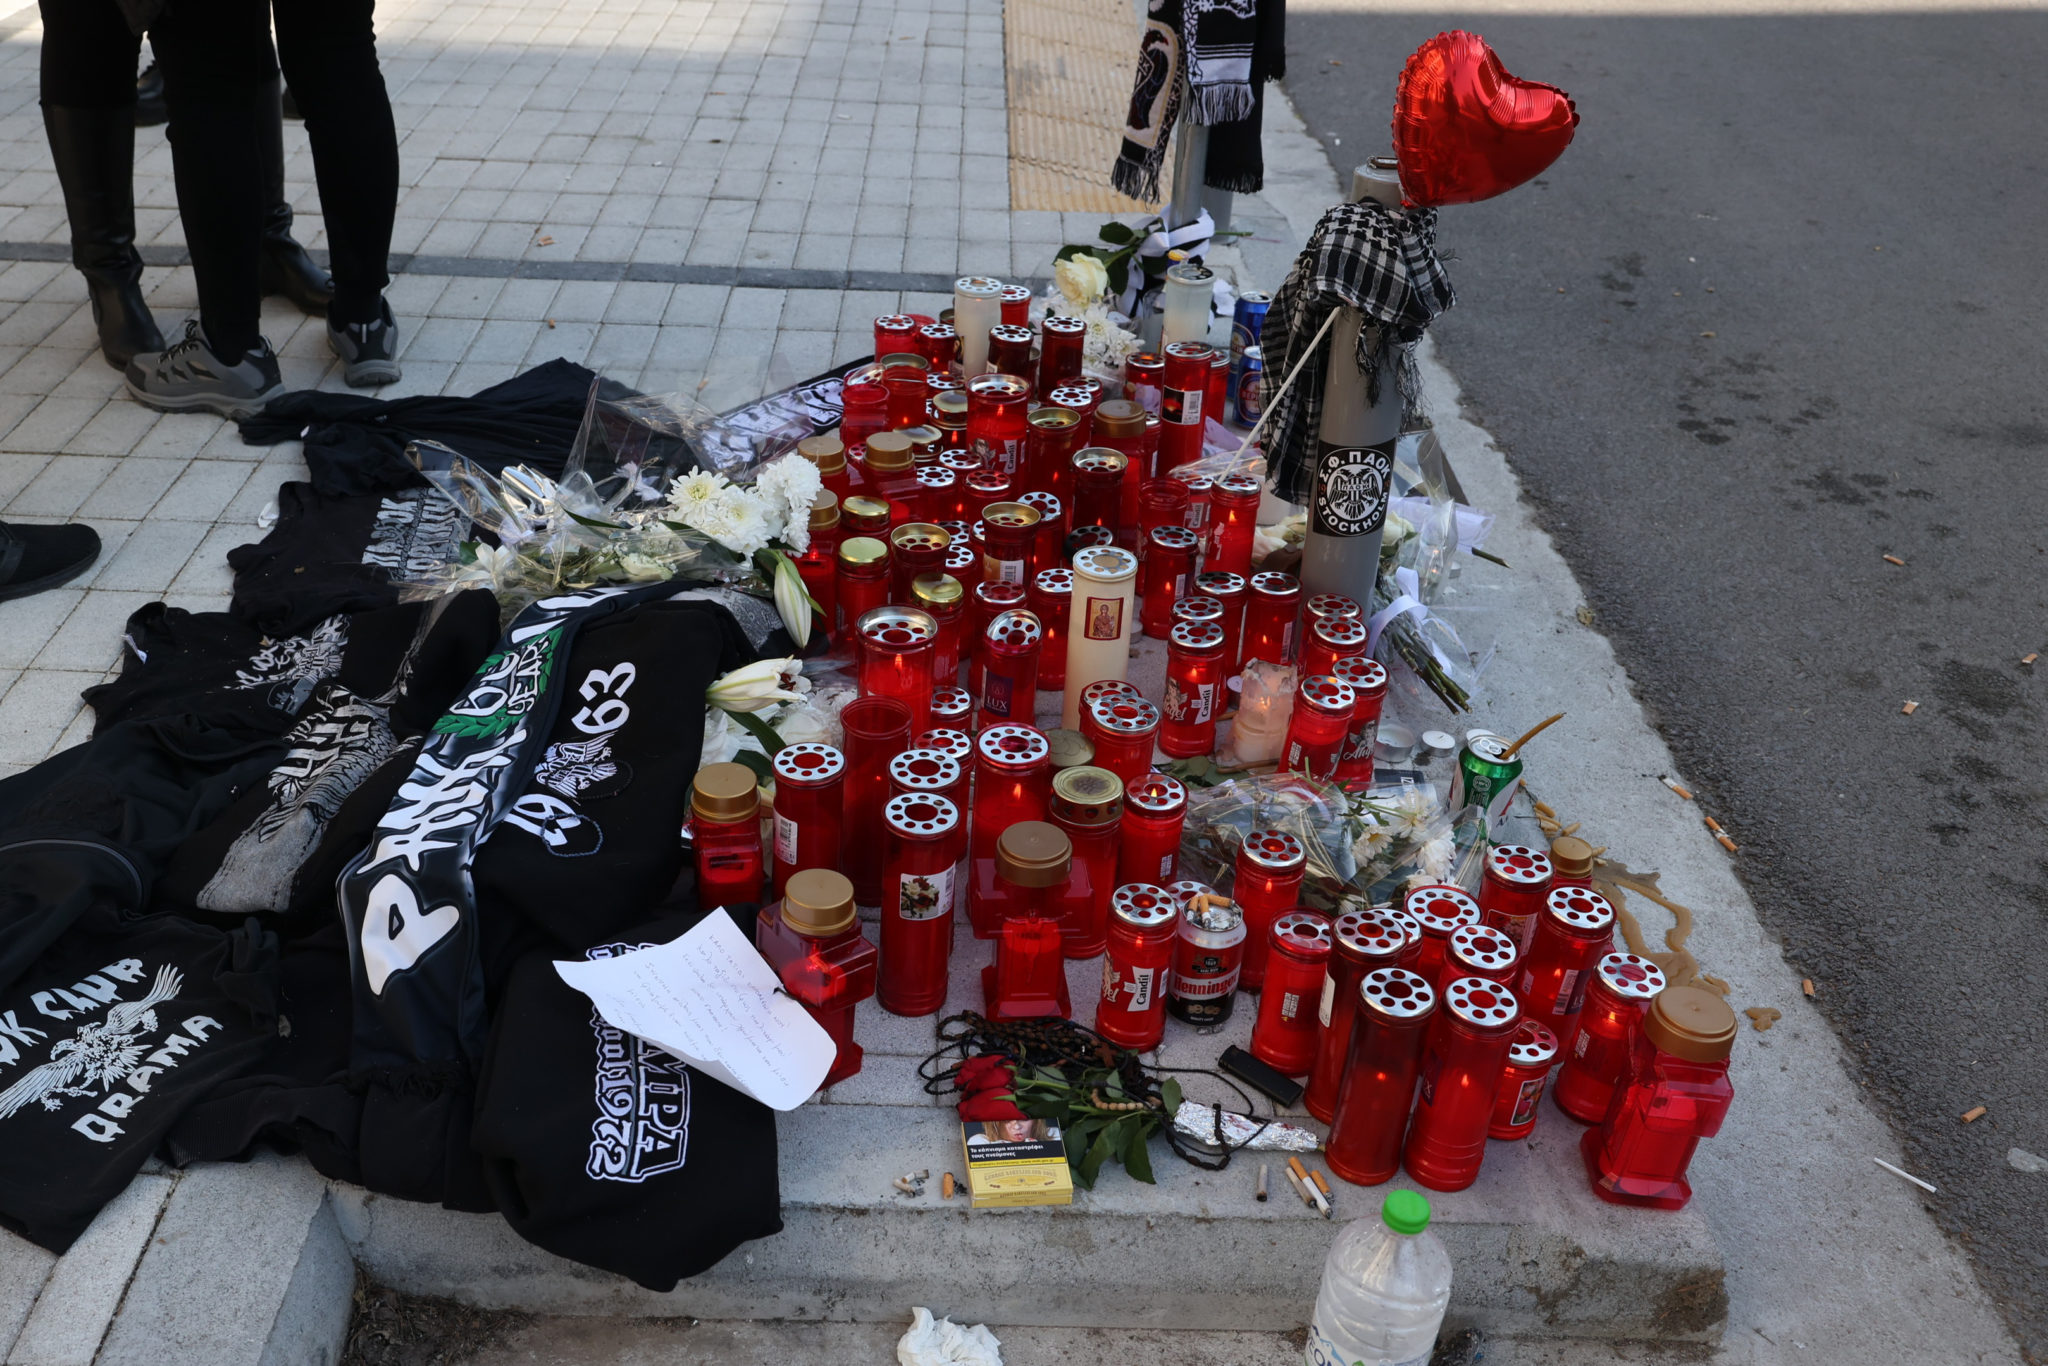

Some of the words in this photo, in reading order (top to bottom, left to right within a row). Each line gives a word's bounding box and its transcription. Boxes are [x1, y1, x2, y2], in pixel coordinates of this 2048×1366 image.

[1348, 451, 1391, 480] ΠΑΟΚ
[1318, 491, 1388, 533] STOCKHOLM
[570, 661, 637, 734] 63
[1201, 689, 1211, 718] Candil
[30, 958, 148, 1021] CLUB
[1136, 974, 1149, 1005] Candil
[71, 1015, 224, 1143] DRAMA
